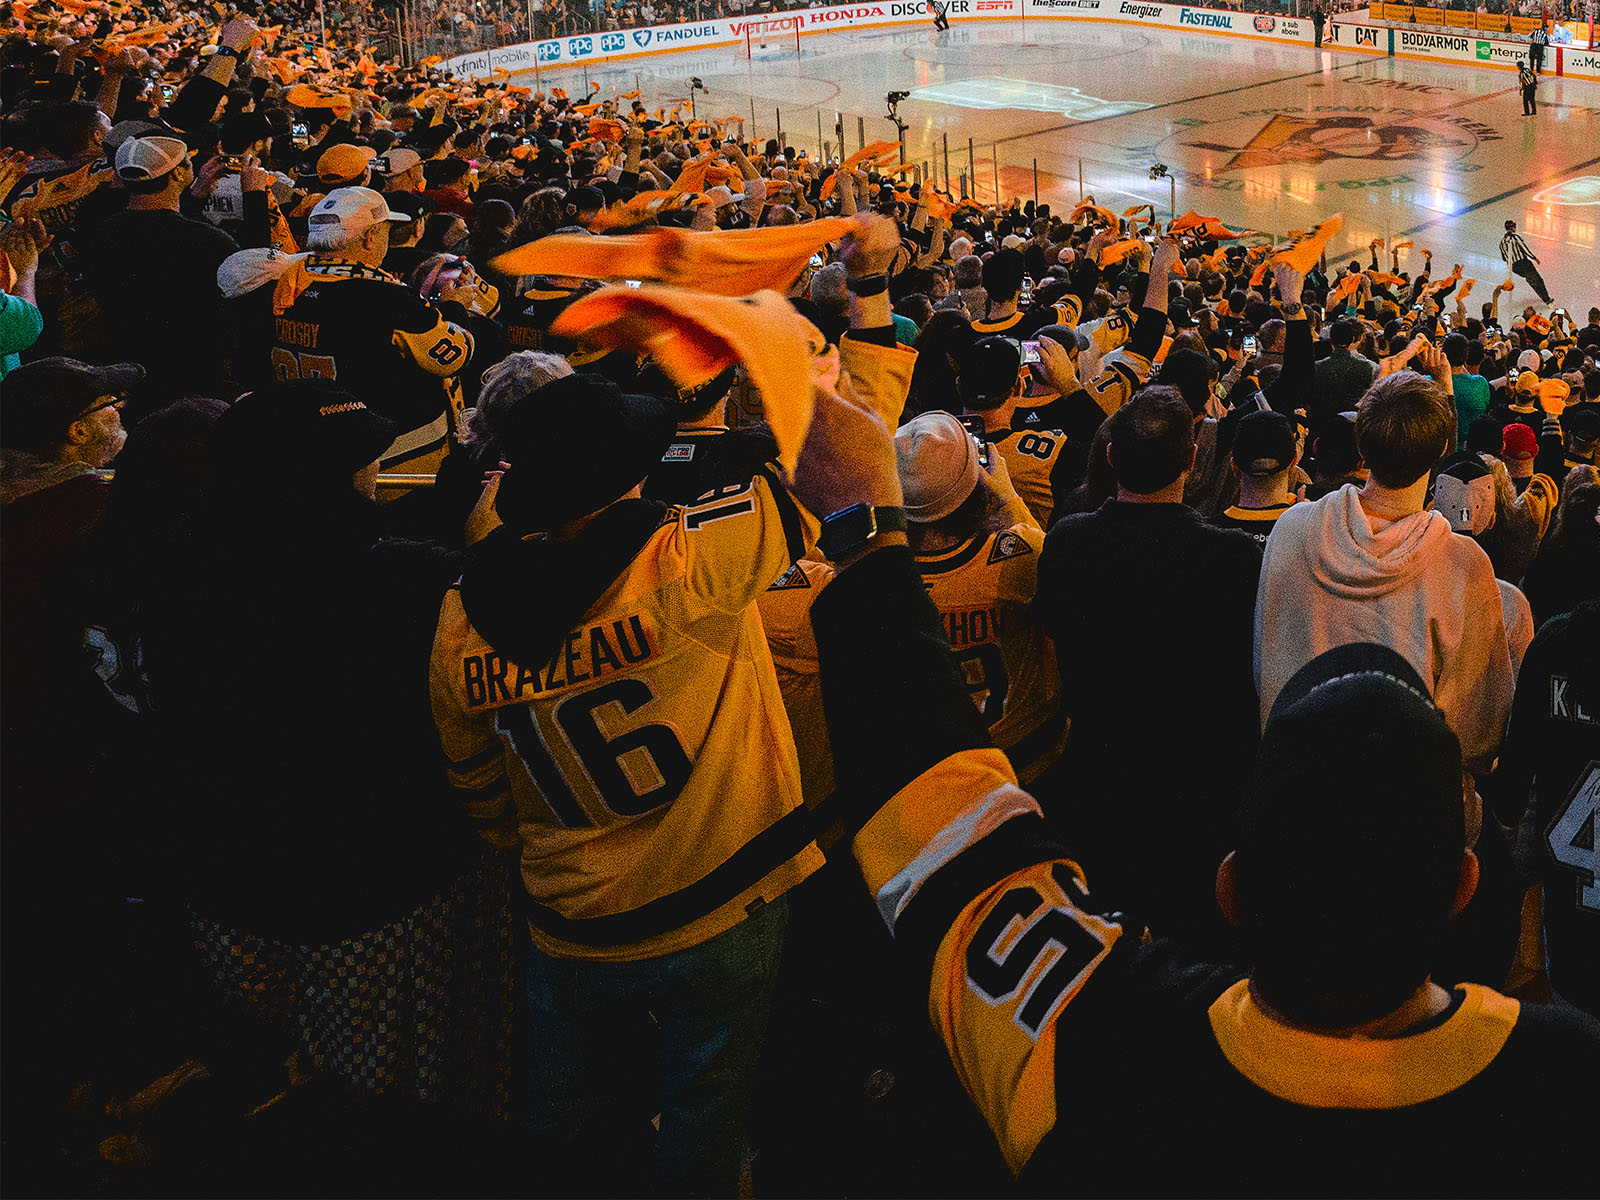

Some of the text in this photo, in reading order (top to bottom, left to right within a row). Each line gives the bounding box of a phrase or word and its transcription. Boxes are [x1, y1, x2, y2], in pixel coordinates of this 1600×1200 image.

[976, 0, 1014, 11] ESPN
[1078, 0, 1100, 9] BET
[1120, 0, 1163, 18] Energizer
[810, 5, 885, 25] HONDA
[1180, 7, 1233, 30] FASTENAL
[656, 25, 719, 42] FANDUEL
[729, 14, 804, 38] verizon
[1281, 28, 1300, 37] above
[570, 39, 591, 55] PPG
[602, 35, 623, 50] PPG
[1355, 27, 1379, 47] CAT
[1401, 31, 1469, 52] BODYARMOR
[539, 43, 560, 59] PPG
[455, 47, 530, 77] xfinity mobile
[276, 316, 320, 349] CROSBY
[463, 614, 651, 707] BRAZEAU
[494, 676, 696, 830] 16
